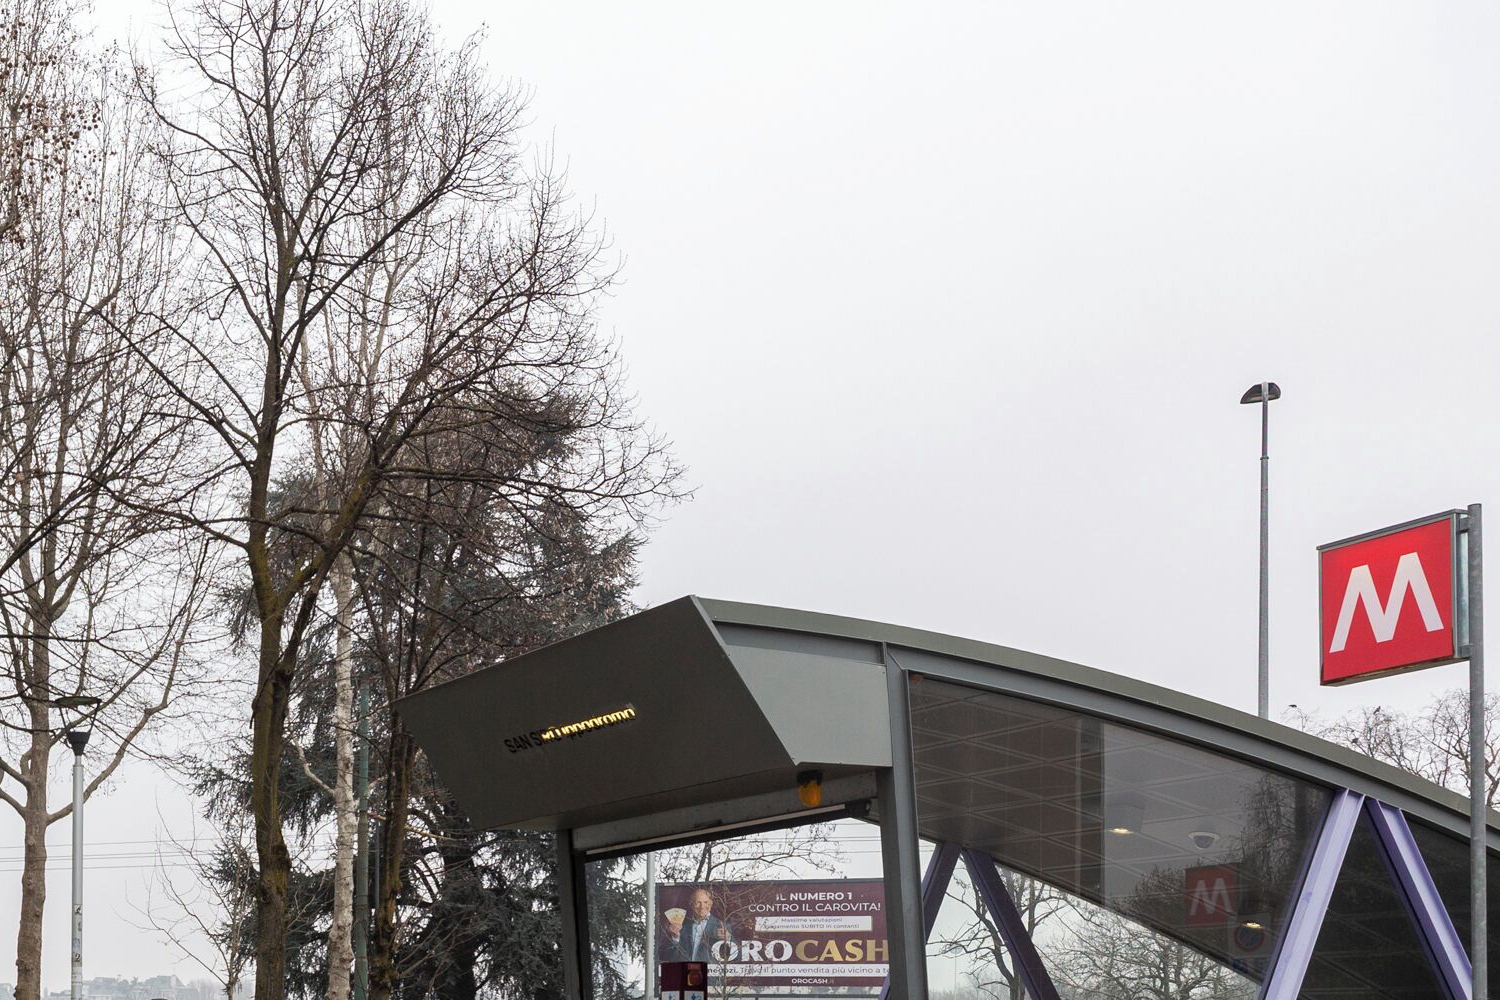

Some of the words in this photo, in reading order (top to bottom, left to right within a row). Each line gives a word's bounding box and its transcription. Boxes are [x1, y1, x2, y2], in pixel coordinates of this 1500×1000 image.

[1329, 551, 1445, 654] M
[504, 734, 532, 754] SAN
[790, 892, 845, 900] NUMERO
[846, 892, 853, 900] 1
[748, 903, 800, 913] CONTRO
[802, 903, 814, 912] IL
[815, 902, 881, 912] CAROVITA!
[771, 967, 796, 975] punto
[797, 966, 831, 974] vendita
[832, 966, 846, 974] più
[847, 966, 874, 974] vicino
